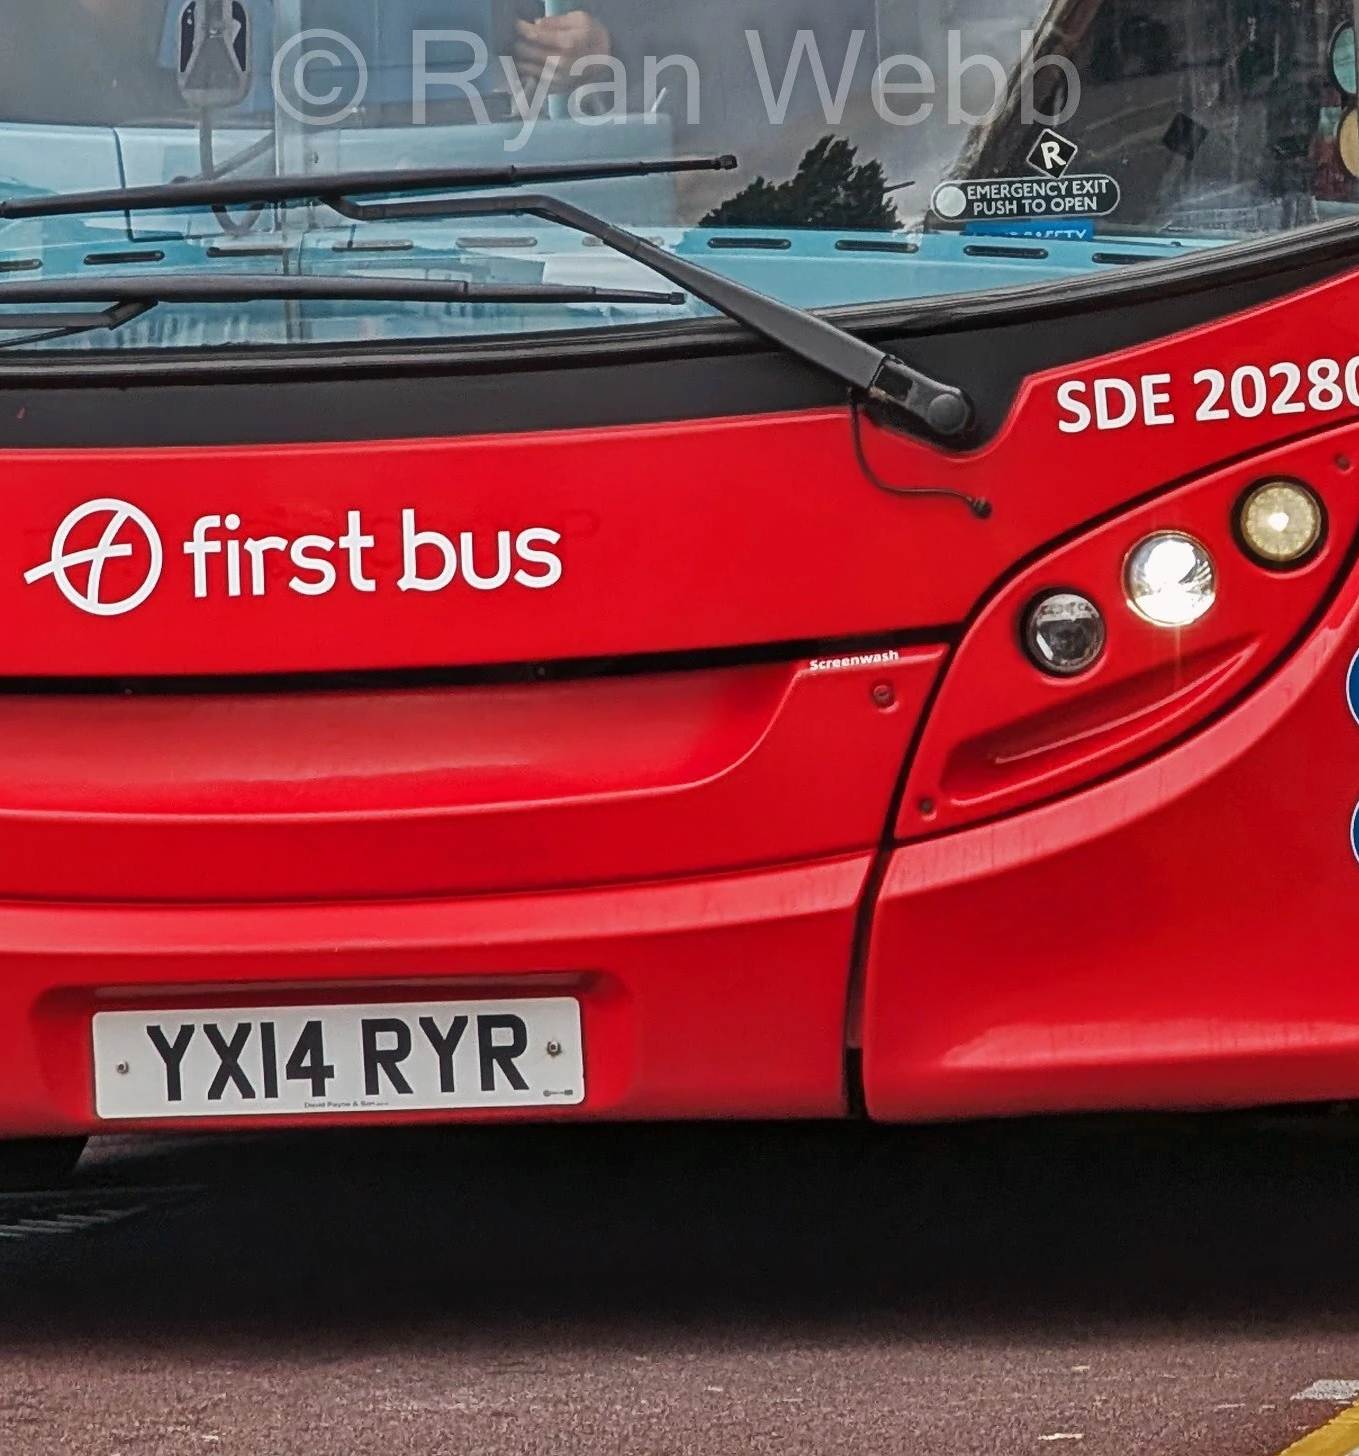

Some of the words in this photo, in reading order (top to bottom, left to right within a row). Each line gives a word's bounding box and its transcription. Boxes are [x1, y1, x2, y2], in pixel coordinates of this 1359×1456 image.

[1040, 141, 1067, 170] R
[966, 180, 1069, 200] EMERGENCY
[1072, 178, 1110, 196] EXIT
[973, 199, 1018, 216] PUSH
[1021, 198, 1047, 214] TO
[1050, 196, 1098, 212] OPEN
[1056, 372, 1175, 434] SDE
[182, 509, 377, 599] first
[396, 508, 563, 593] bus
[808, 649, 900, 672] Screenwash
[145, 1019, 336, 1102] YX14
[360, 1013, 531, 1096] RYR
